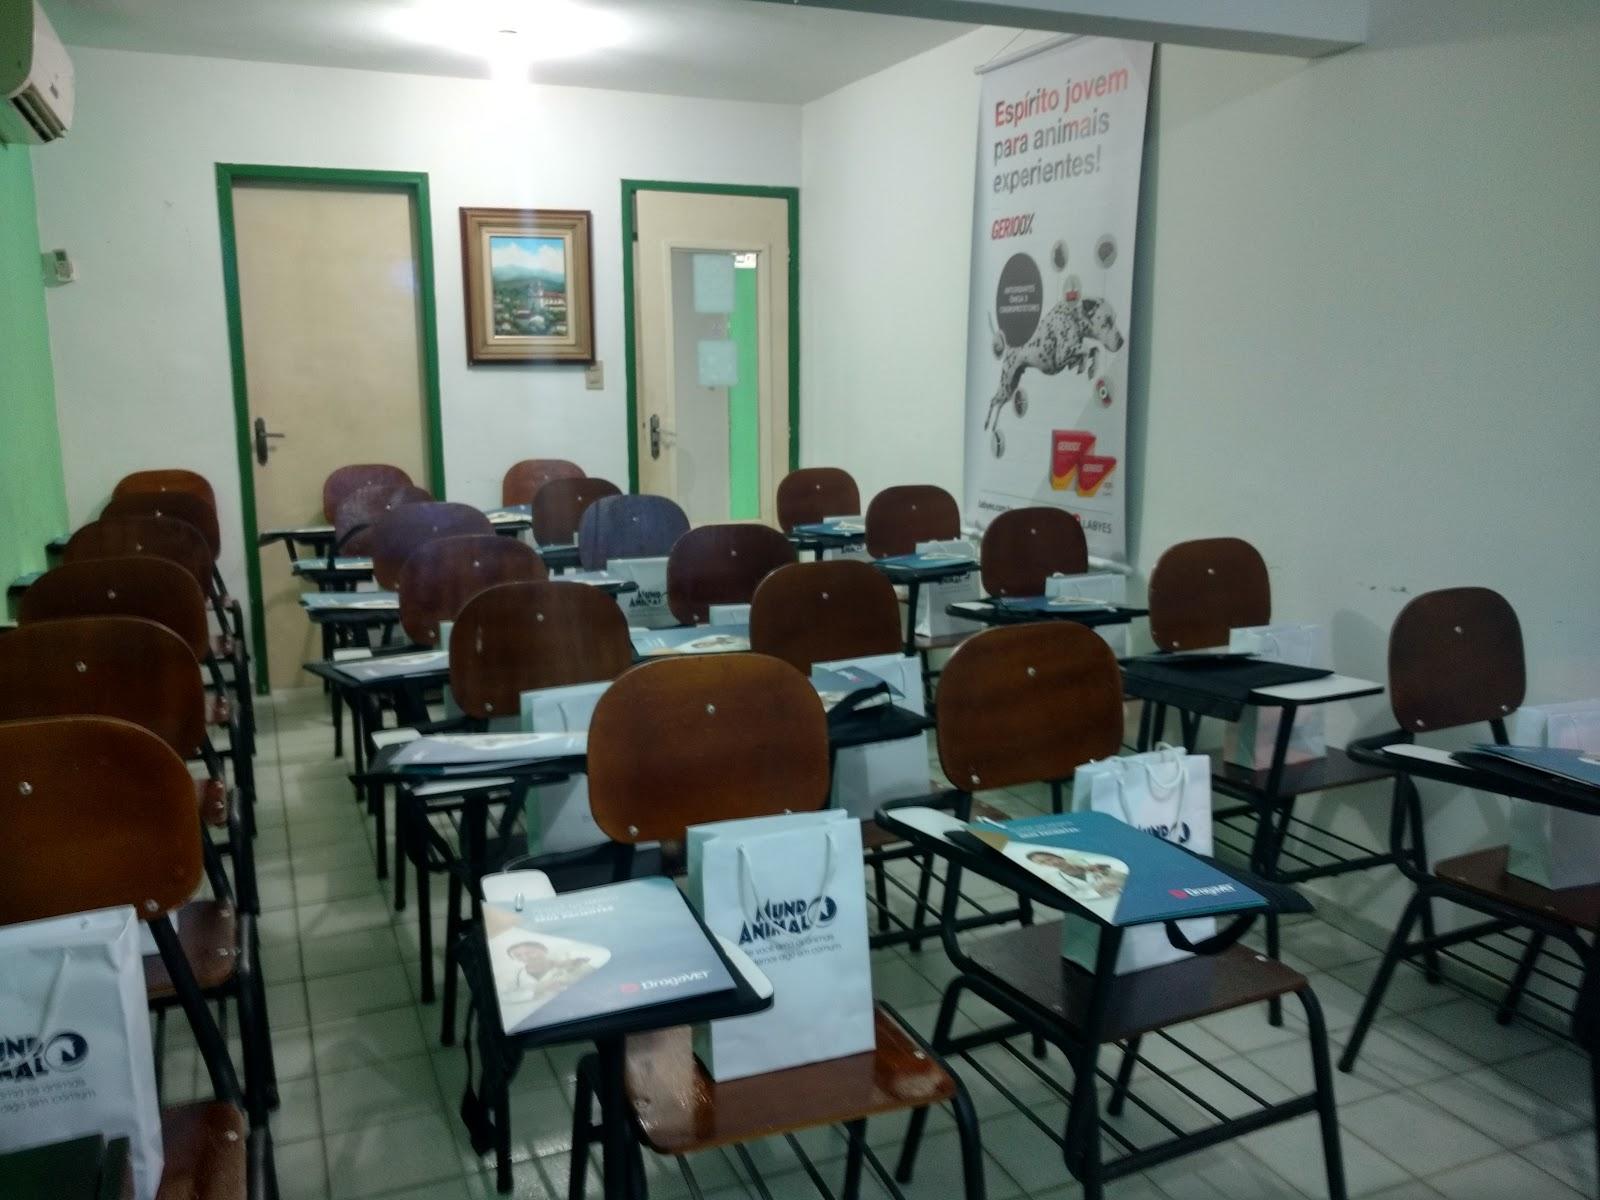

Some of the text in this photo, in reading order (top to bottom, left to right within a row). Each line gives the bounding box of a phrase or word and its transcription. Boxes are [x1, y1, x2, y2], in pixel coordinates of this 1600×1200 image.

[995, 68, 1129, 128] Espírito jovem
[994, 107, 1111, 166] para animais
[994, 144, 1103, 194] experientes!
